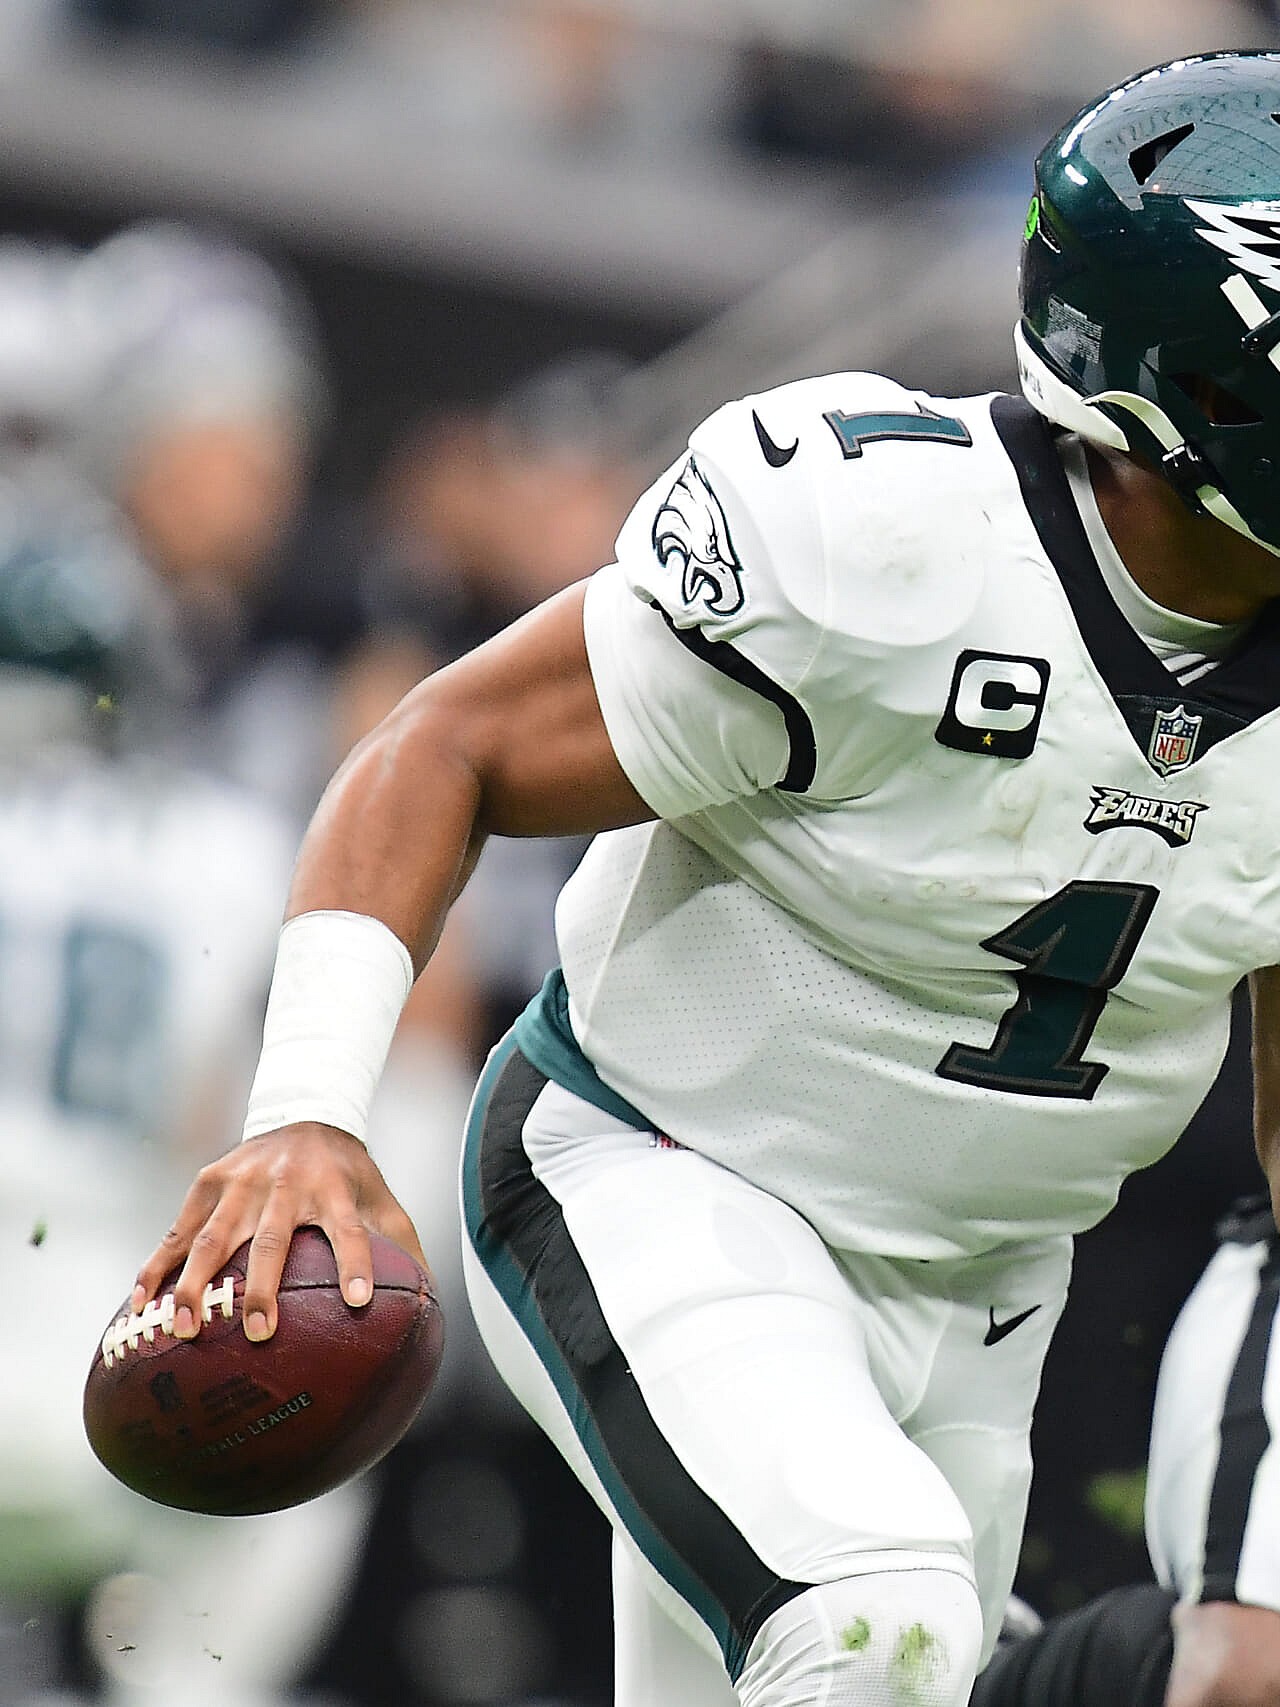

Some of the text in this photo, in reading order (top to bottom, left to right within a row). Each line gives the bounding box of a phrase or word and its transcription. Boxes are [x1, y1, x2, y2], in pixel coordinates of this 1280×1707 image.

[823, 401, 972, 460] 1
[954, 660, 1041, 731] C
[1156, 735, 1187, 763] NFL
[1086, 786, 1207, 844] EAGLES
[935, 879, 1160, 1101] 1
[250, 1390, 312, 1436] LEAGUE
